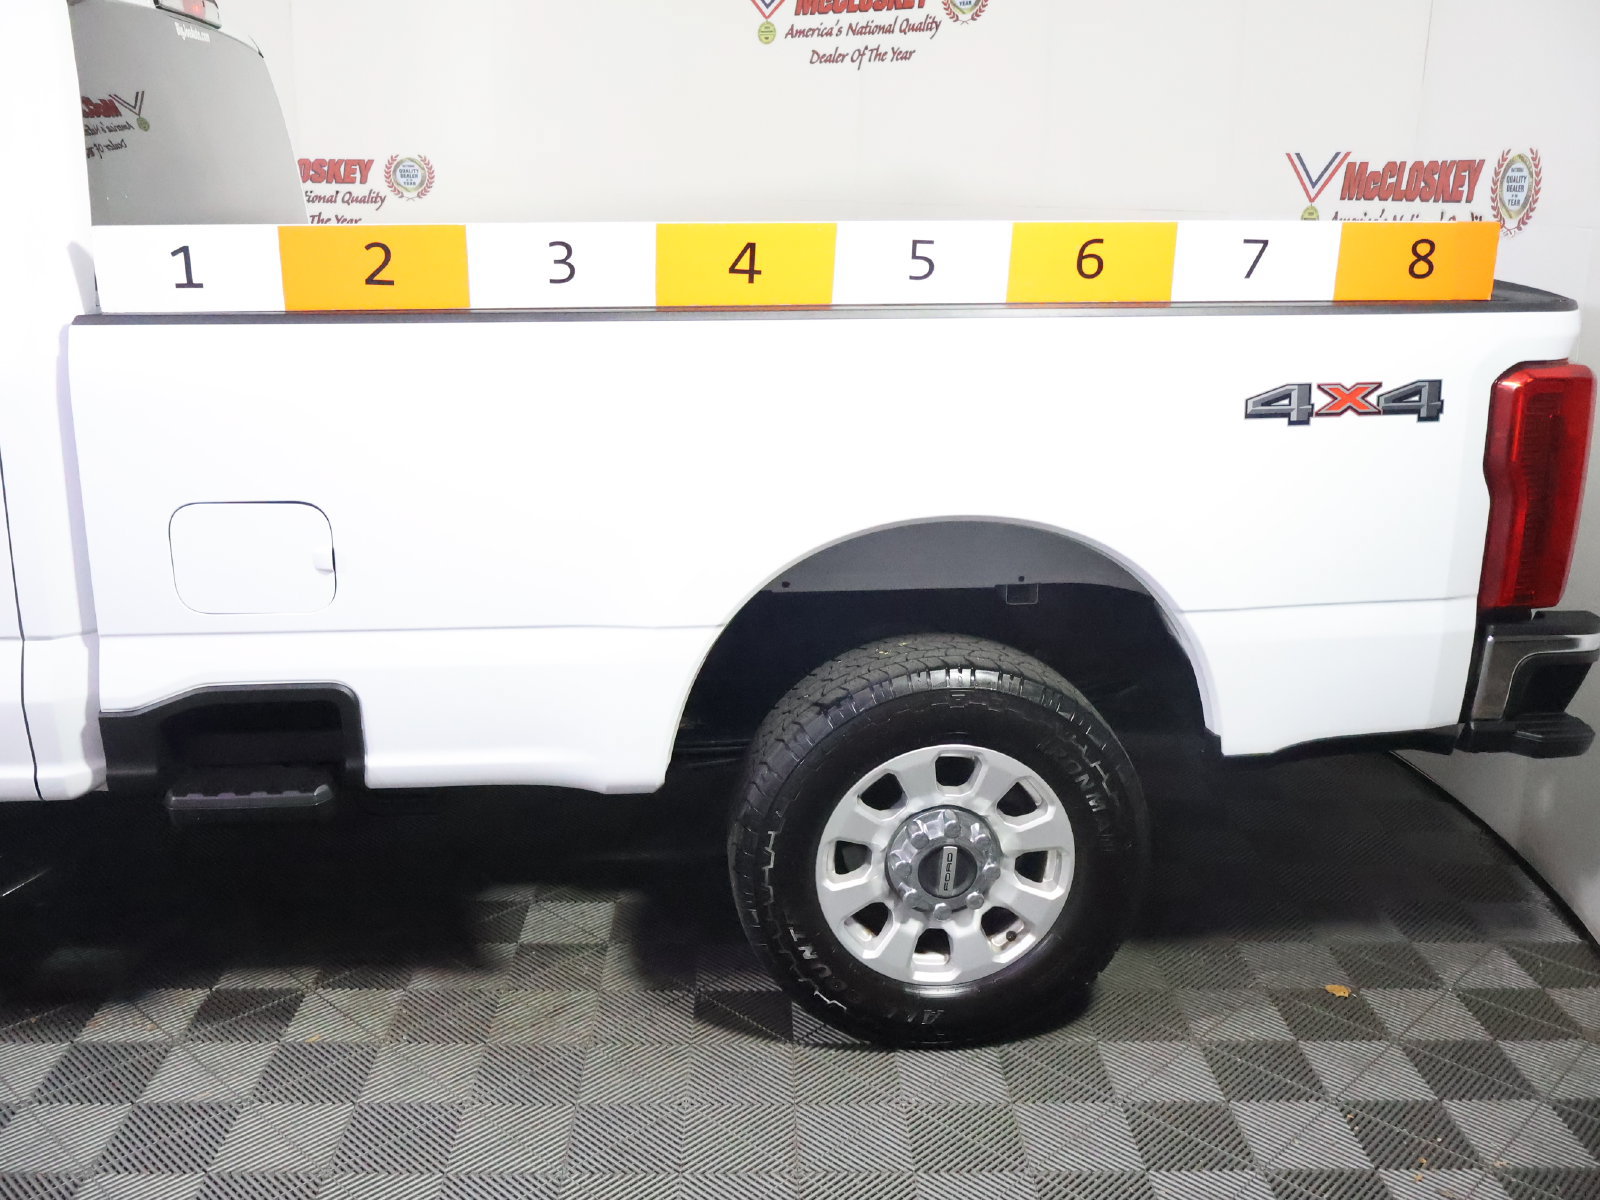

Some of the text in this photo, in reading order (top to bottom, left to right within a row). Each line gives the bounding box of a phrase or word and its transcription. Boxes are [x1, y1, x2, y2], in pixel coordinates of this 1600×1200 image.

[784, 19, 843, 39] America's
[846, 15, 899, 37] National
[899, 13, 942, 40] Quality
[809, 44, 916, 71] Dealer Of The Year
[297, 158, 375, 185] OSKEY
[1340, 159, 1486, 204] McCLOSKEY
[341, 189, 387, 211] Quality
[1506, 184, 1525, 193] DEALER
[171, 239, 1436, 289] 1 2 3 4 5 6 7 8
[943, 852, 954, 891] FORD
